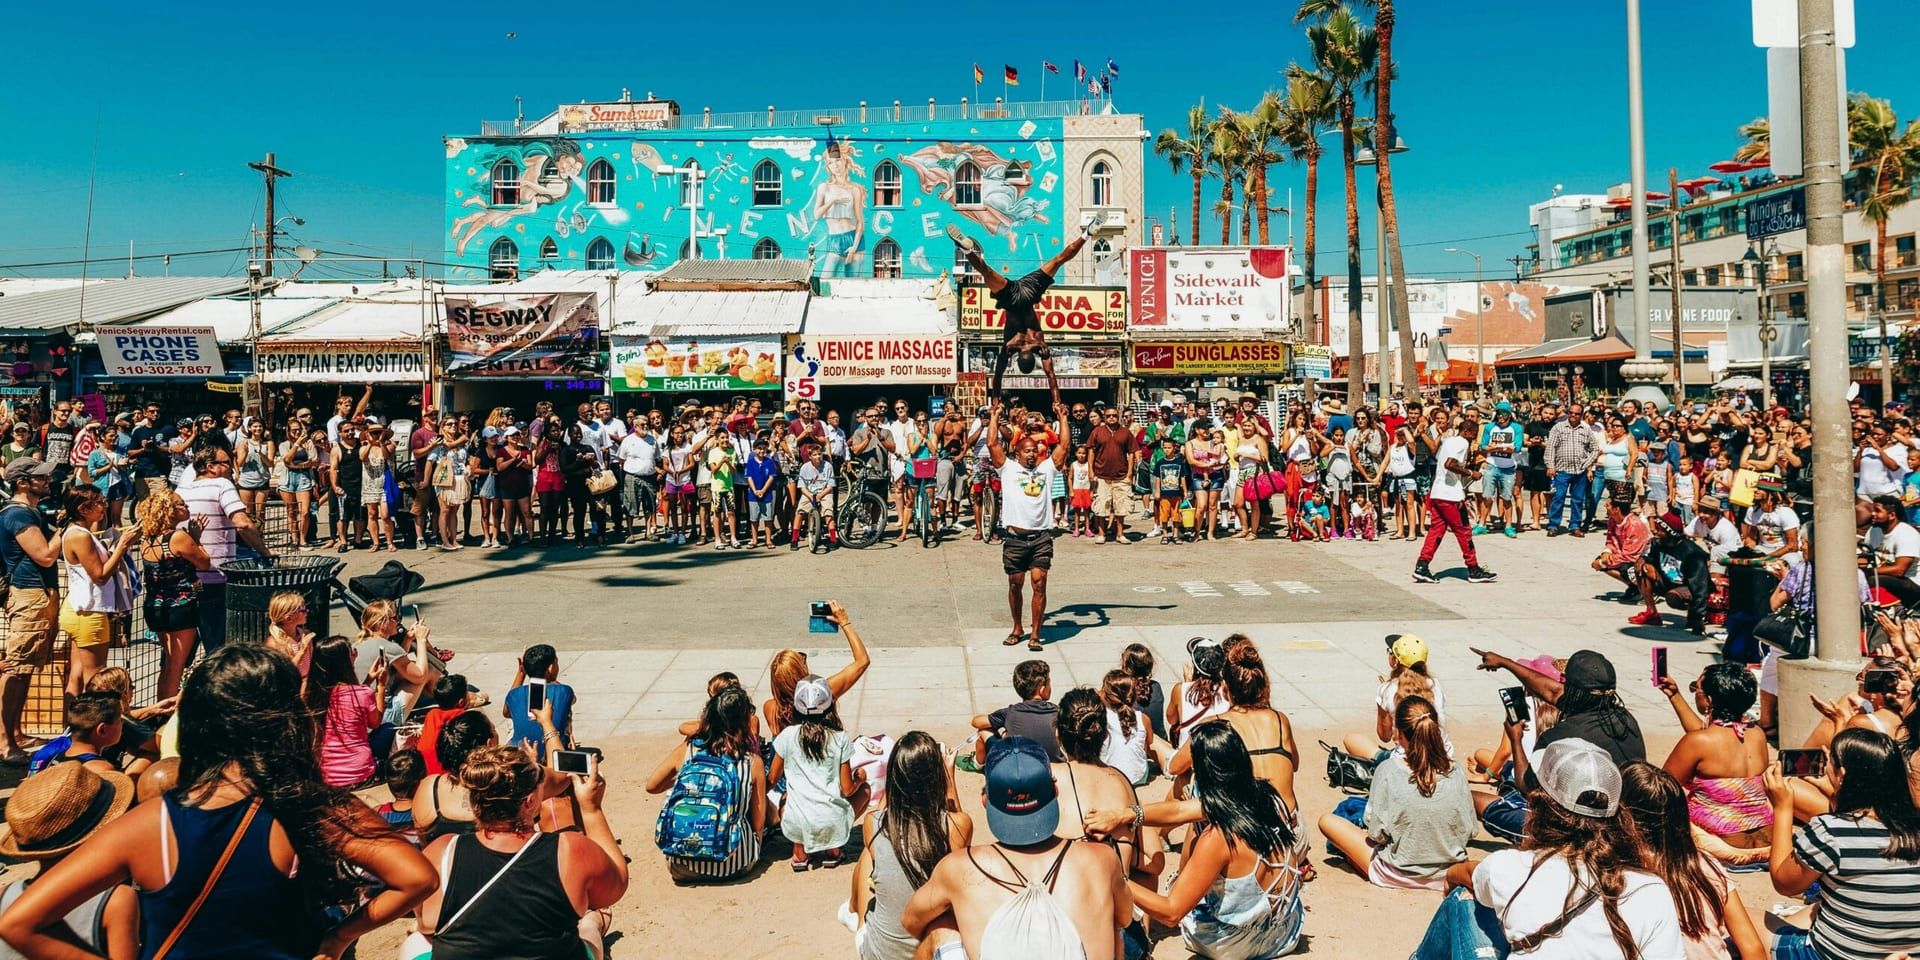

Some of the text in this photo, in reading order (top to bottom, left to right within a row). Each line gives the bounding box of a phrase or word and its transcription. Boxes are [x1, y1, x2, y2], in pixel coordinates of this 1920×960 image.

[589, 105, 665, 122] Samesun
[1749, 200, 1784, 221] Windwa
[1139, 252, 1156, 322] VENICE
[1173, 272, 1262, 288] Sidewalk
[965, 288, 977, 305] 2
[1034, 295, 1092, 311] NNA
[1110, 292, 1122, 308] 2
[1175, 291, 1244, 306] Market
[453, 303, 554, 327] SEGWAY
[962, 316, 980, 327] $10
[983, 309, 1104, 330] TTOOS
[1665, 308, 1697, 322] WNE
[1701, 308, 1731, 322] FOOD
[96, 327, 211, 336] VeniceSegwayRental.com
[1107, 320, 1124, 330] $10
[115, 336, 199, 348] PHONE
[122, 349, 200, 361] CASES
[817, 339, 953, 362] VENICE MASSAGE
[1176, 345, 1280, 362] SUNGLASSES
[117, 366, 212, 375] 310-302-7867
[257, 353, 424, 374] EGYPTIAN EXPOSITION
[823, 365, 847, 377] BODY
[848, 365, 885, 378] Massage
[890, 365, 913, 376] FOOT
[915, 364, 952, 377] Massage
[663, 378, 730, 390] Fresh Fruit
[787, 377, 816, 399] $5
